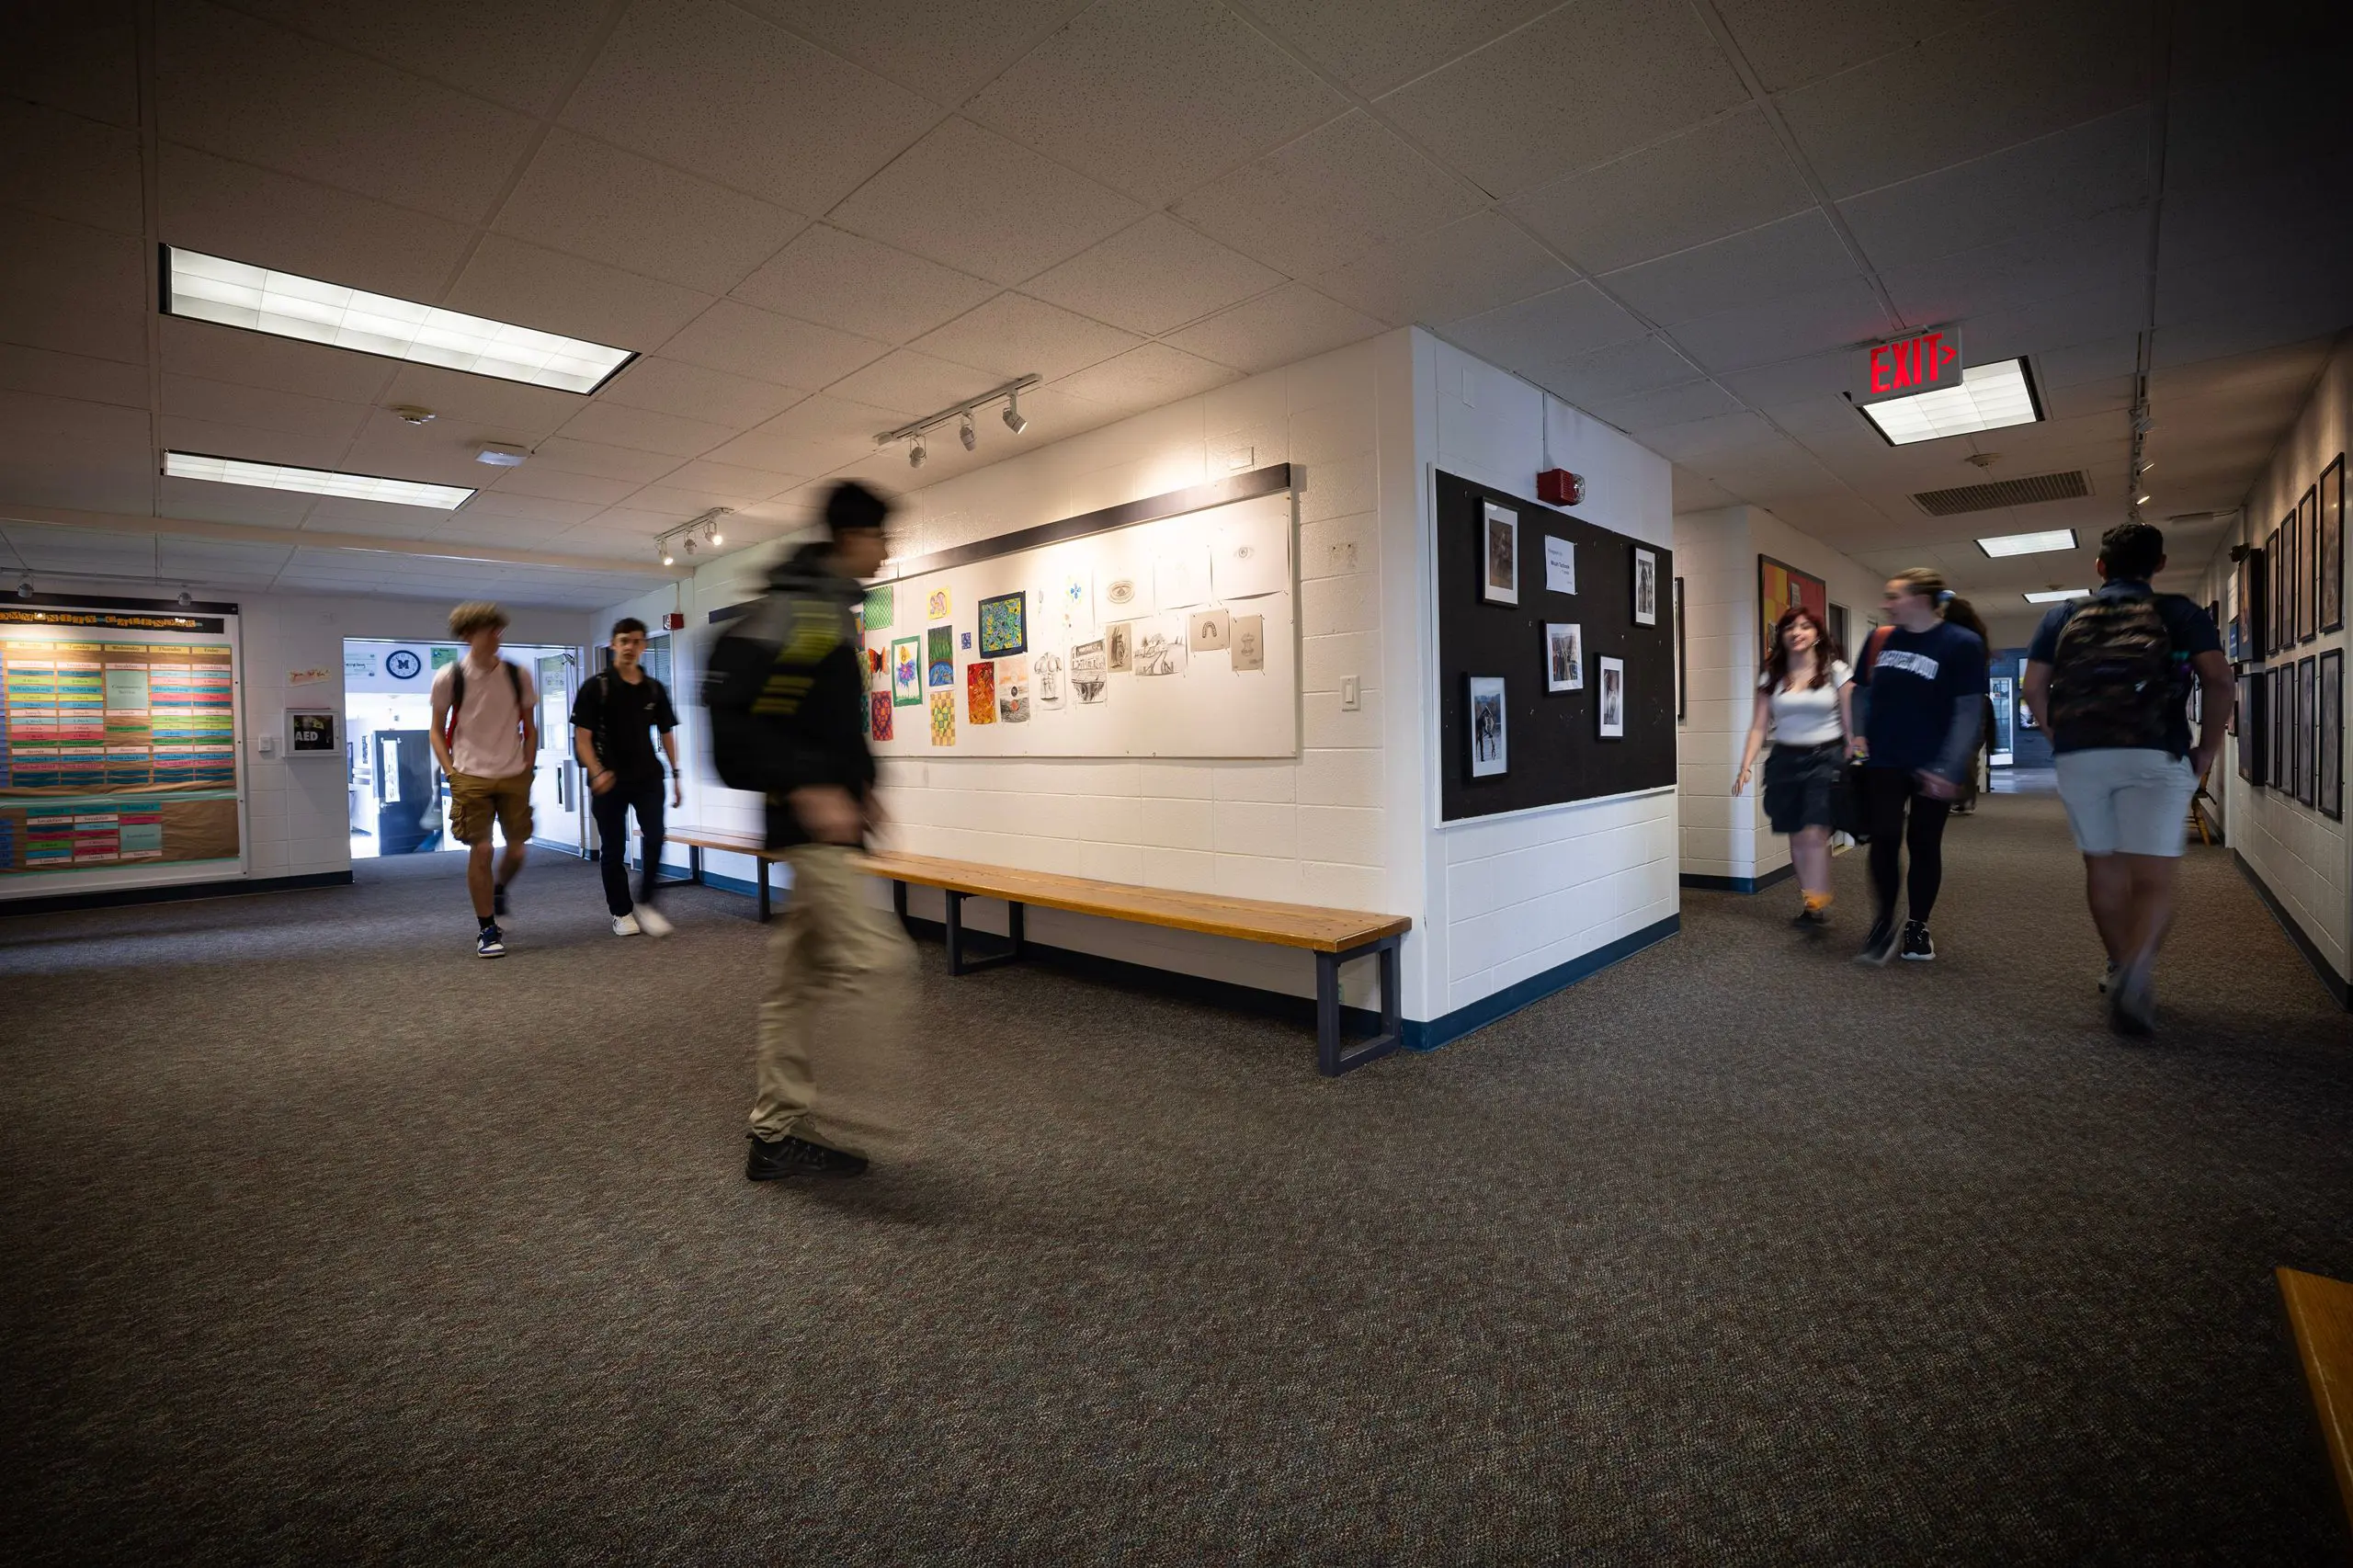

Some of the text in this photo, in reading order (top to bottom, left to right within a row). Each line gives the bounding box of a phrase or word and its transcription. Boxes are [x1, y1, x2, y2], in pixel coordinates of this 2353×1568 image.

[1870, 331, 1944, 394] EXIT
[0, 612, 196, 628] OMMNITY CALENDR
[398, 659, 409, 669] M
[295, 731, 319, 742] AED
